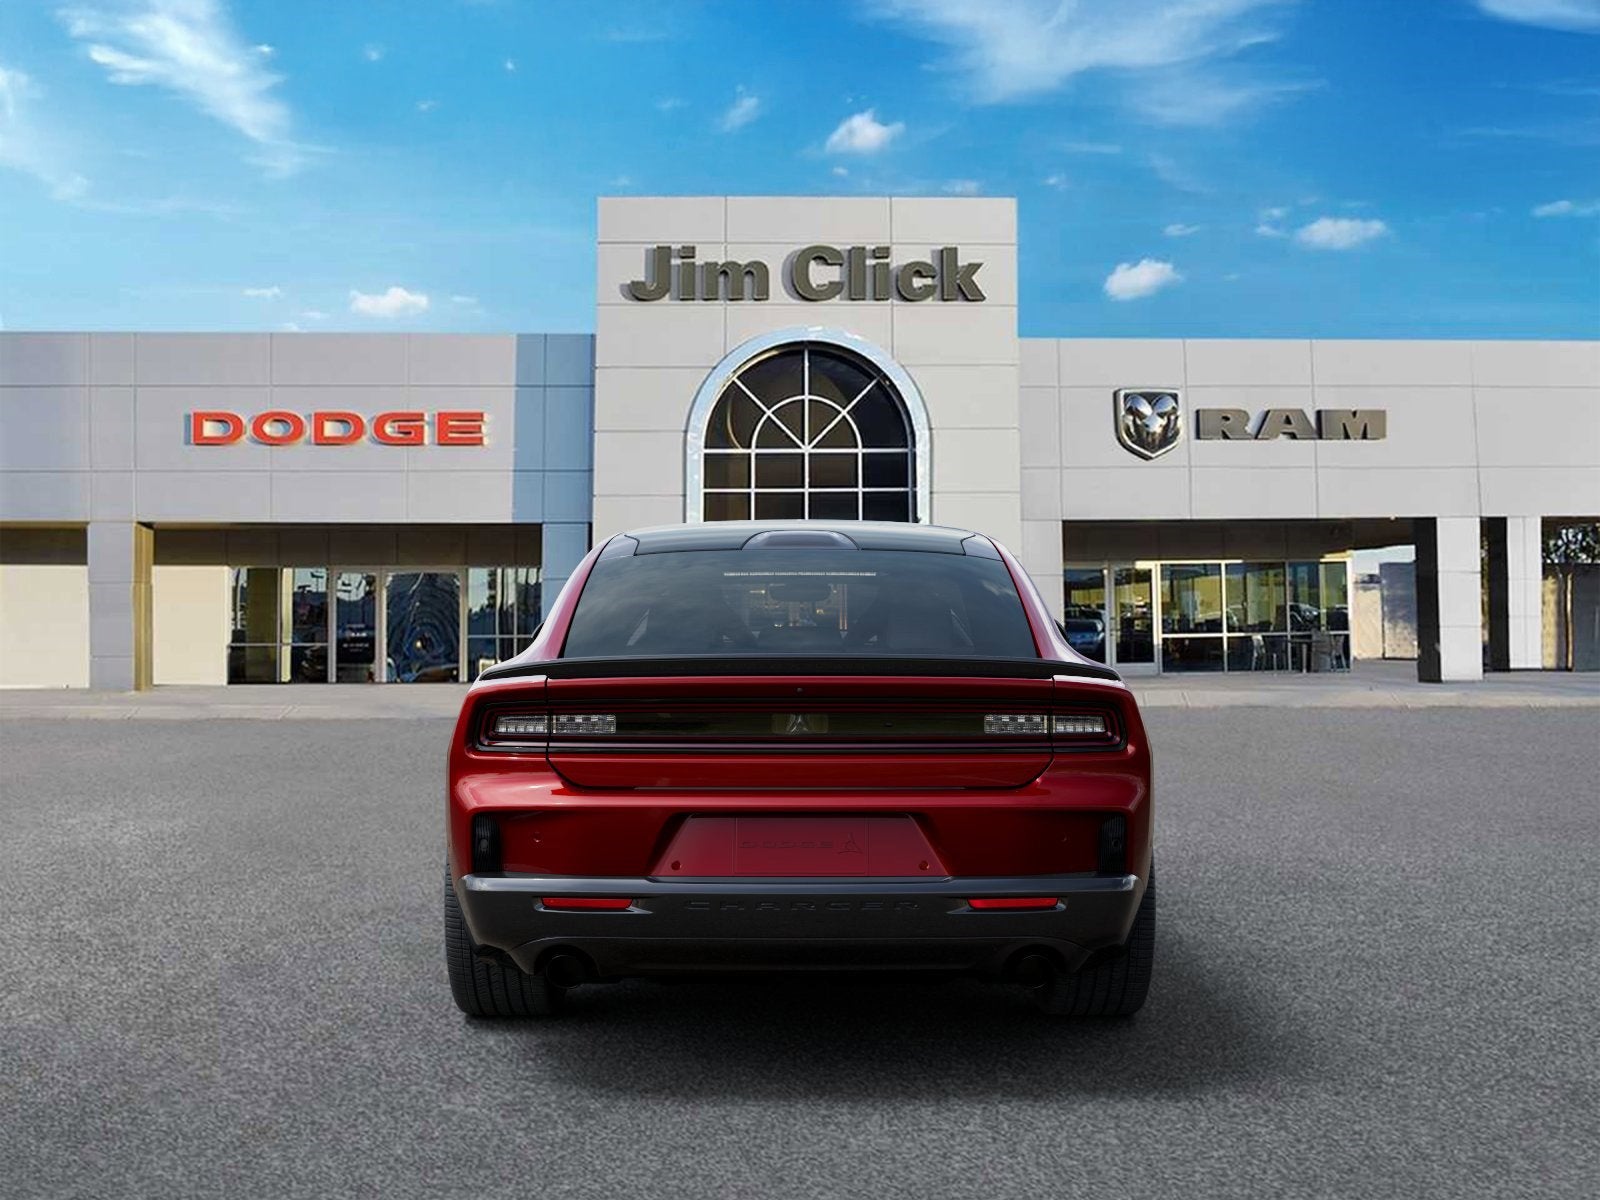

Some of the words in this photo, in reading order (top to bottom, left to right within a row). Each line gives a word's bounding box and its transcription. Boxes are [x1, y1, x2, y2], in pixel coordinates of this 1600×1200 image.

[627, 245, 769, 302] Jim
[788, 245, 986, 302] Click
[190, 410, 486, 447] DODGE
[1195, 408, 1387, 441] RAM
[684, 899, 920, 911] CHARGER
